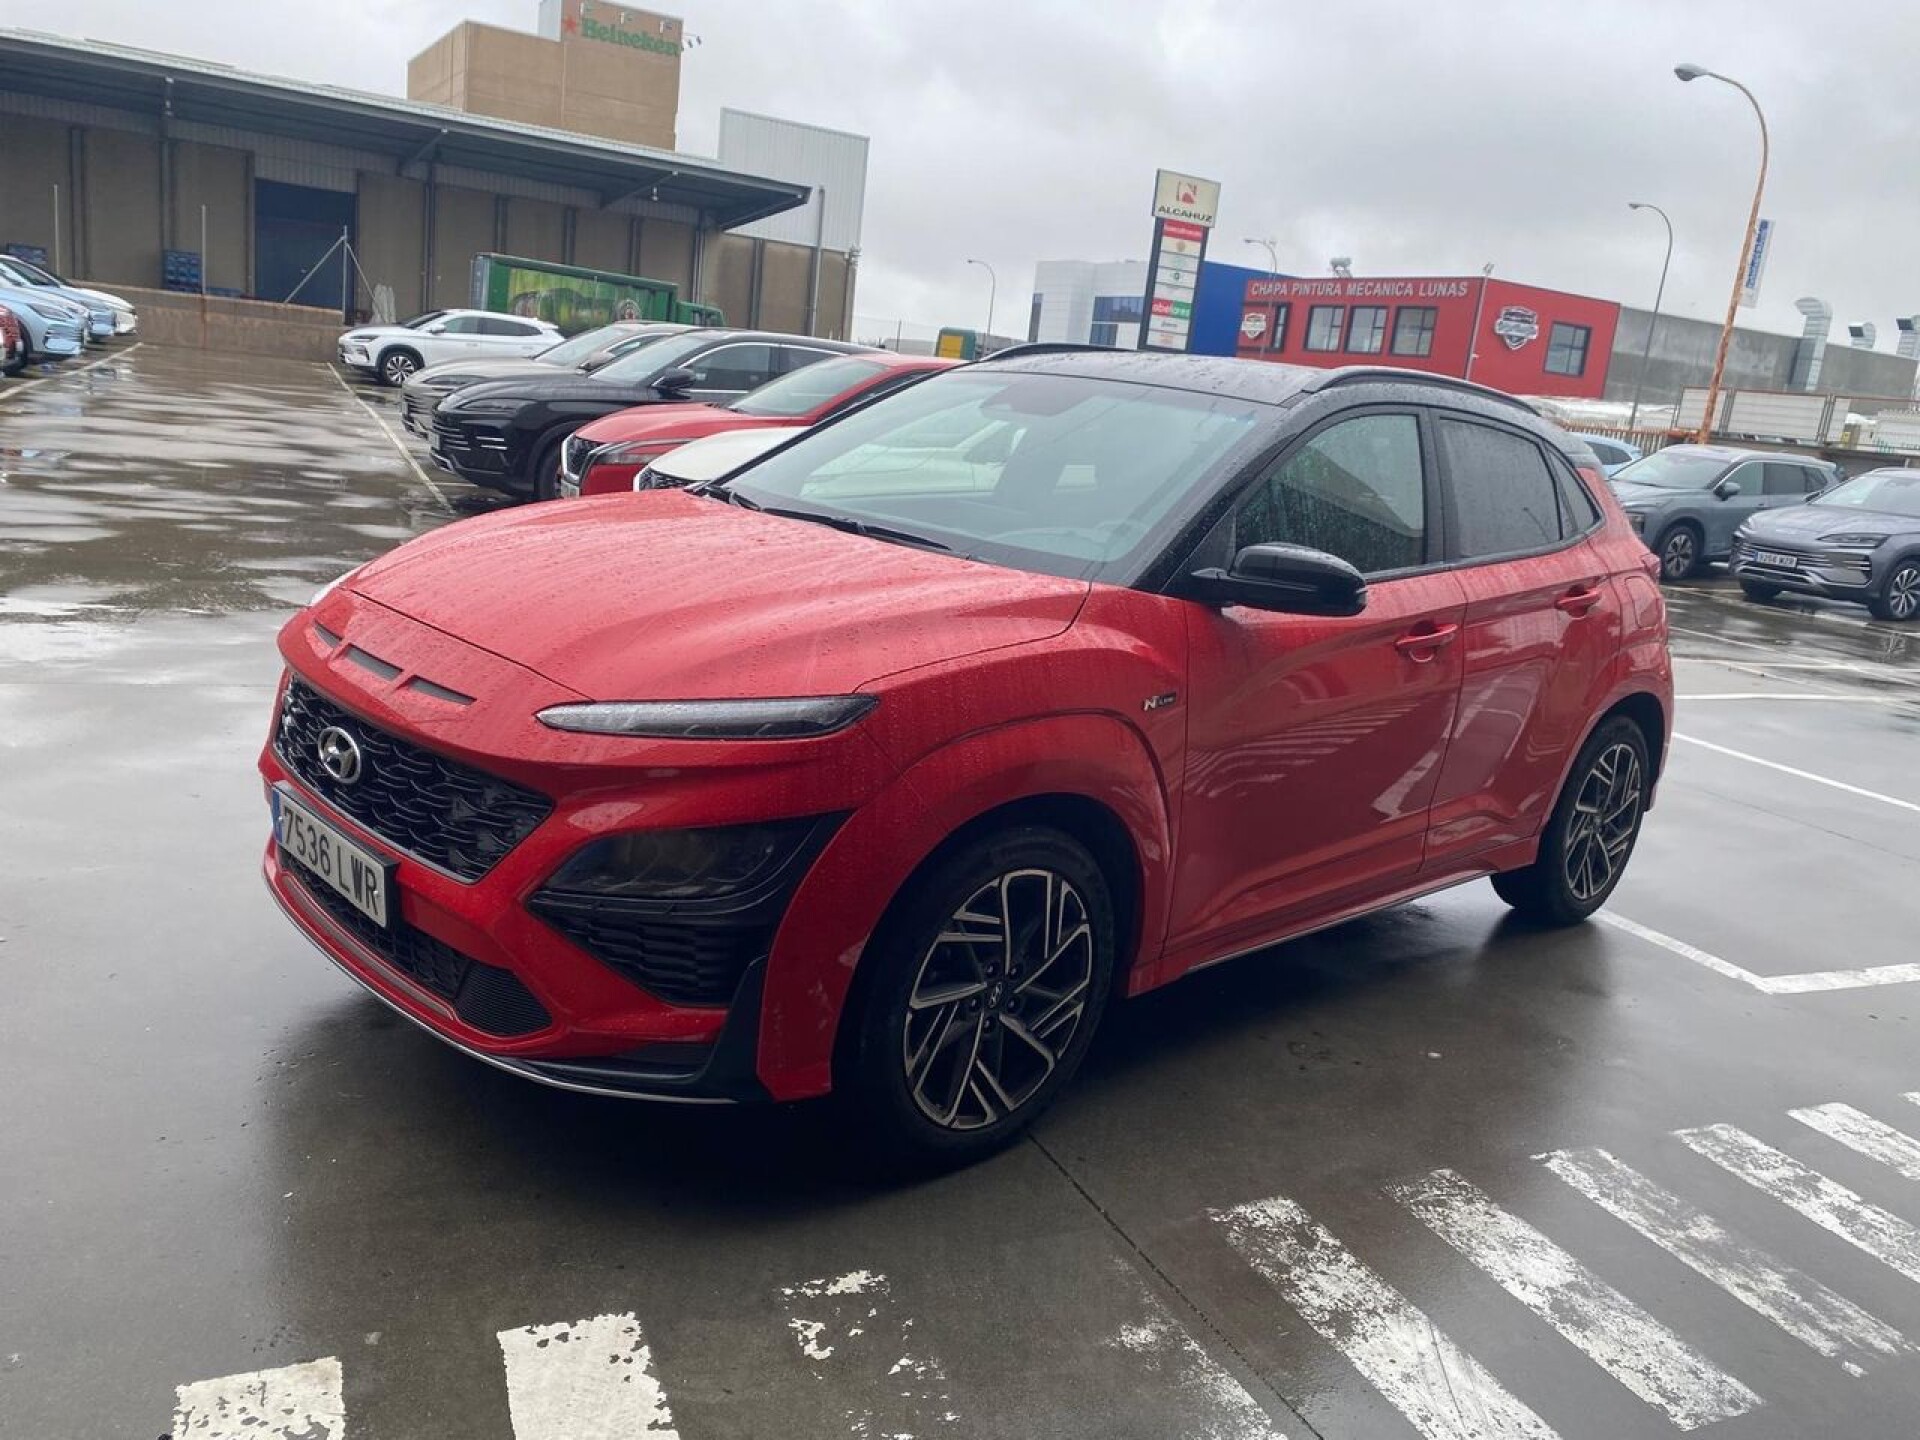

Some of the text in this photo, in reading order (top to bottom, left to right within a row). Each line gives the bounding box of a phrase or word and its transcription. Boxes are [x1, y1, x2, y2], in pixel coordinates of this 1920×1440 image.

[582, 18, 679, 56] Heineken
[1158, 205, 1213, 222] ALCAHUZ
[1251, 282, 1288, 296] CHAPA
[1292, 282, 1342, 296] PINTURA
[1418, 281, 1469, 297] LUNAS
[284, 805, 379, 916] 7536 LWR
